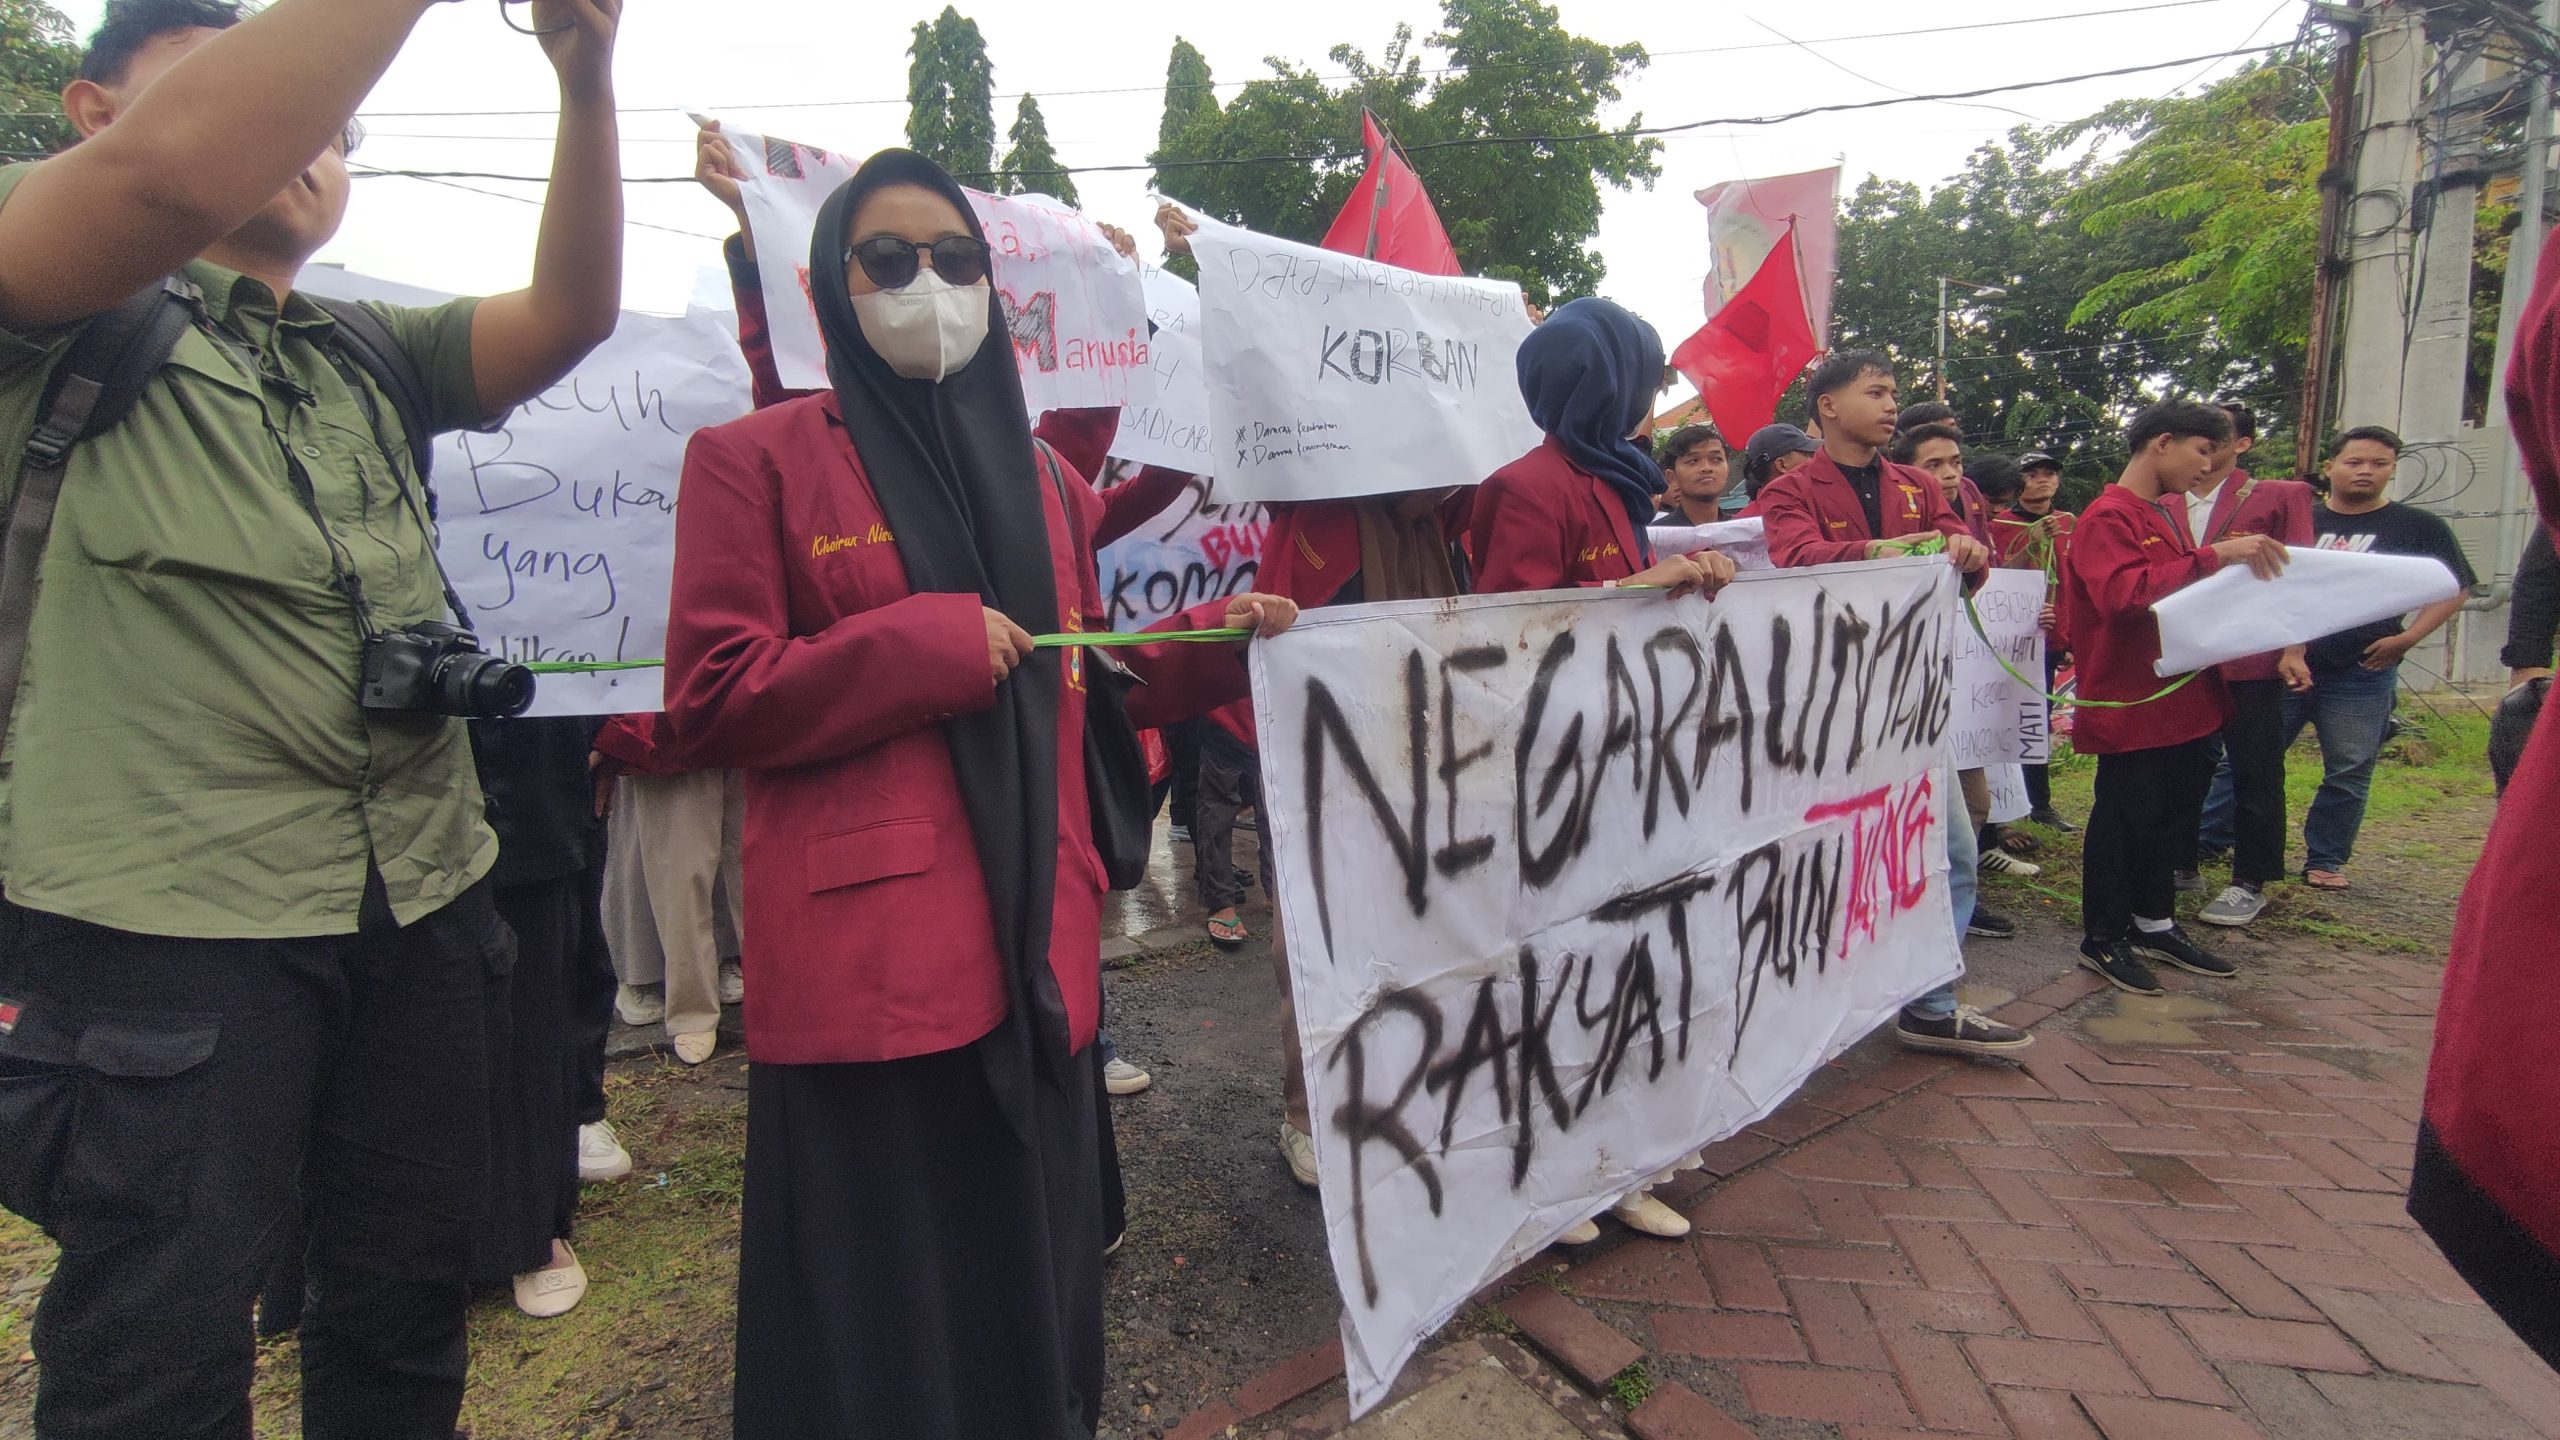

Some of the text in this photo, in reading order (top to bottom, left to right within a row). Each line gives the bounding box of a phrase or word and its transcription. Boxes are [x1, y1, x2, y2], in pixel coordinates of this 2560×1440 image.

[1230, 248, 1329, 305] Data,
[1340, 260, 1434, 304] Malah
[1317, 325, 1478, 397] KORBAN
[476, 533, 617, 620] yang
[2019, 701, 2046, 760] MATI
[1302, 624, 1754, 966] NEGARA
[1325, 873, 1717, 1309] RAKYAT
